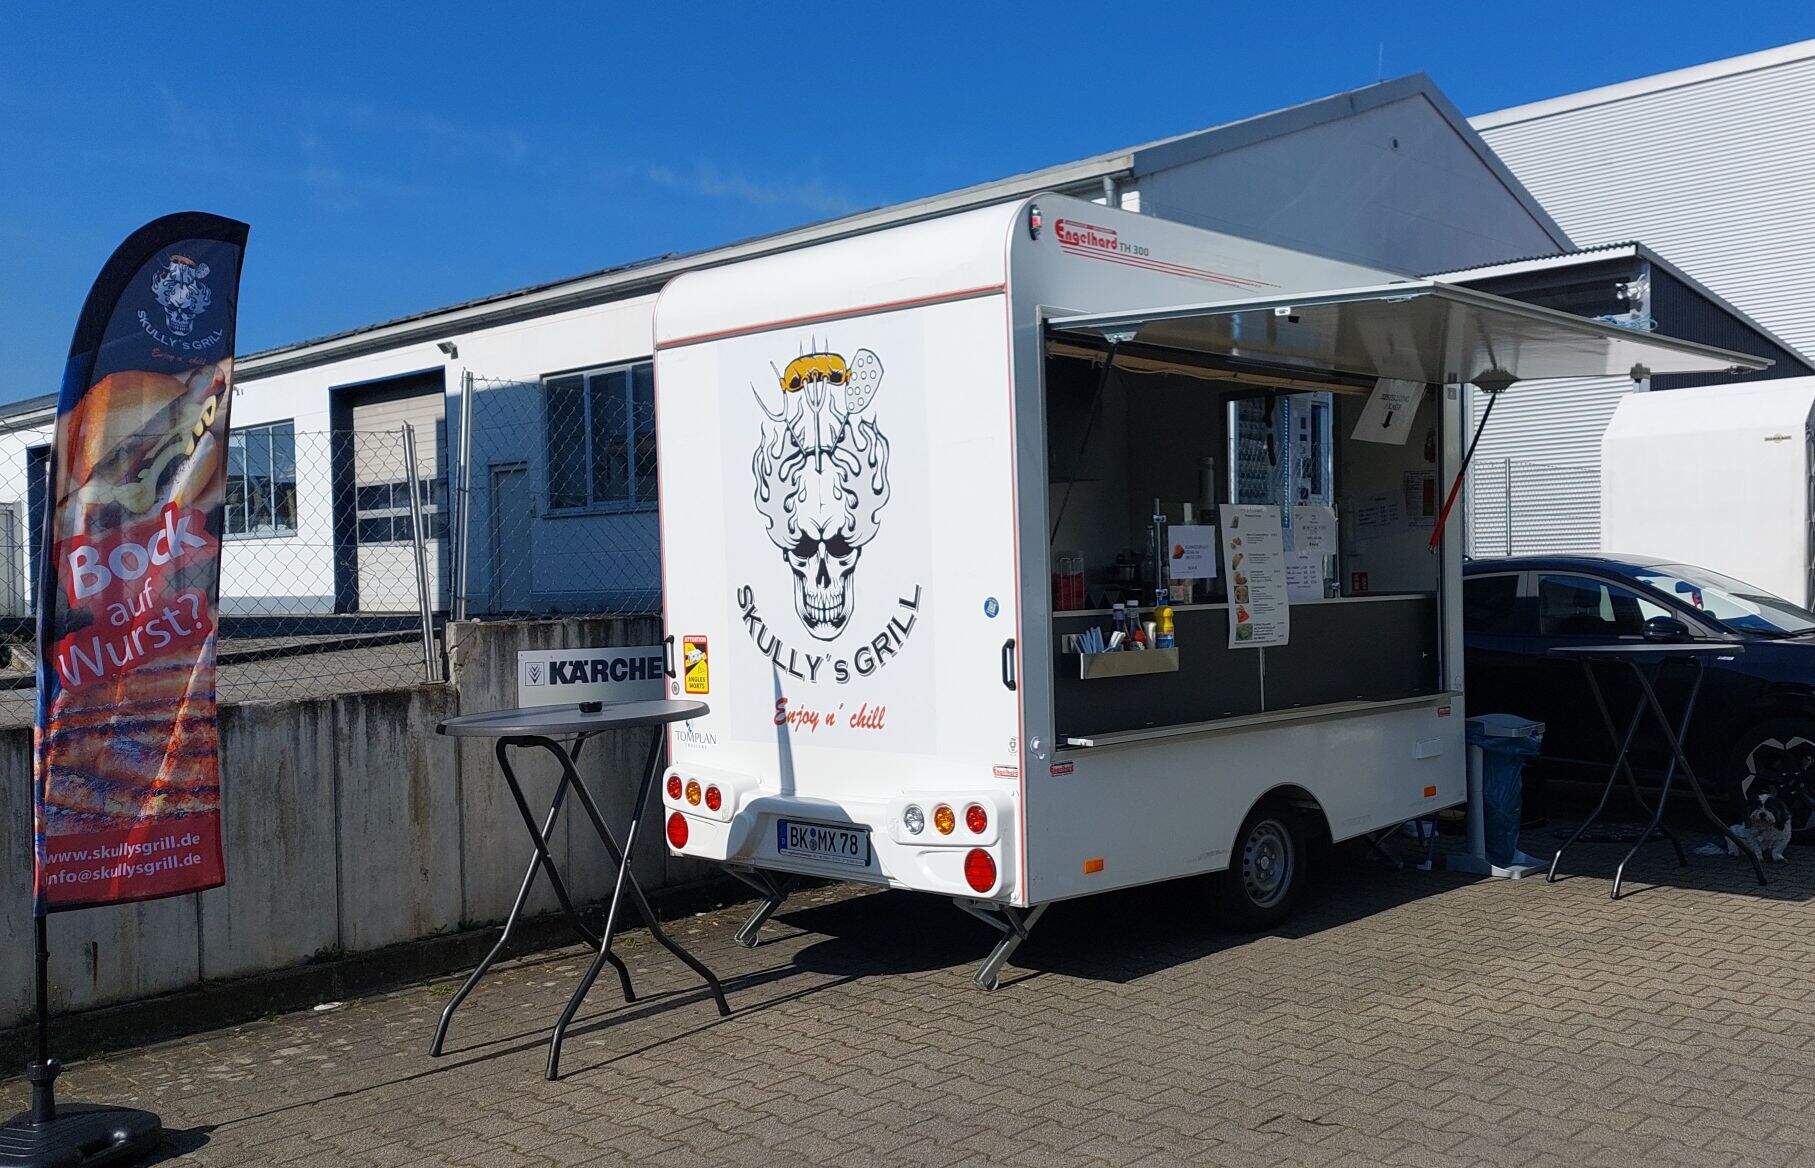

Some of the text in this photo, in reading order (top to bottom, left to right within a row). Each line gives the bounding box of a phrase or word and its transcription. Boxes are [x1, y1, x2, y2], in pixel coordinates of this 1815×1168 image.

[1055, 219, 1149, 256] Engelhard TH 300
[192, 328, 223, 350] GRILL
[67, 510, 208, 600] Bock
[106, 577, 155, 627] auf
[58, 593, 202, 687] Wurst?
[853, 584, 922, 678] GRILL
[774, 697, 820, 734] Enjoy
[849, 703, 886, 730] chill
[674, 730, 718, 745] TOMPLAN
[46, 832, 200, 865] www.skullysgrill.de
[790, 826, 809, 849] BK
[818, 830, 836, 852] MX
[840, 833, 859, 855] 78
